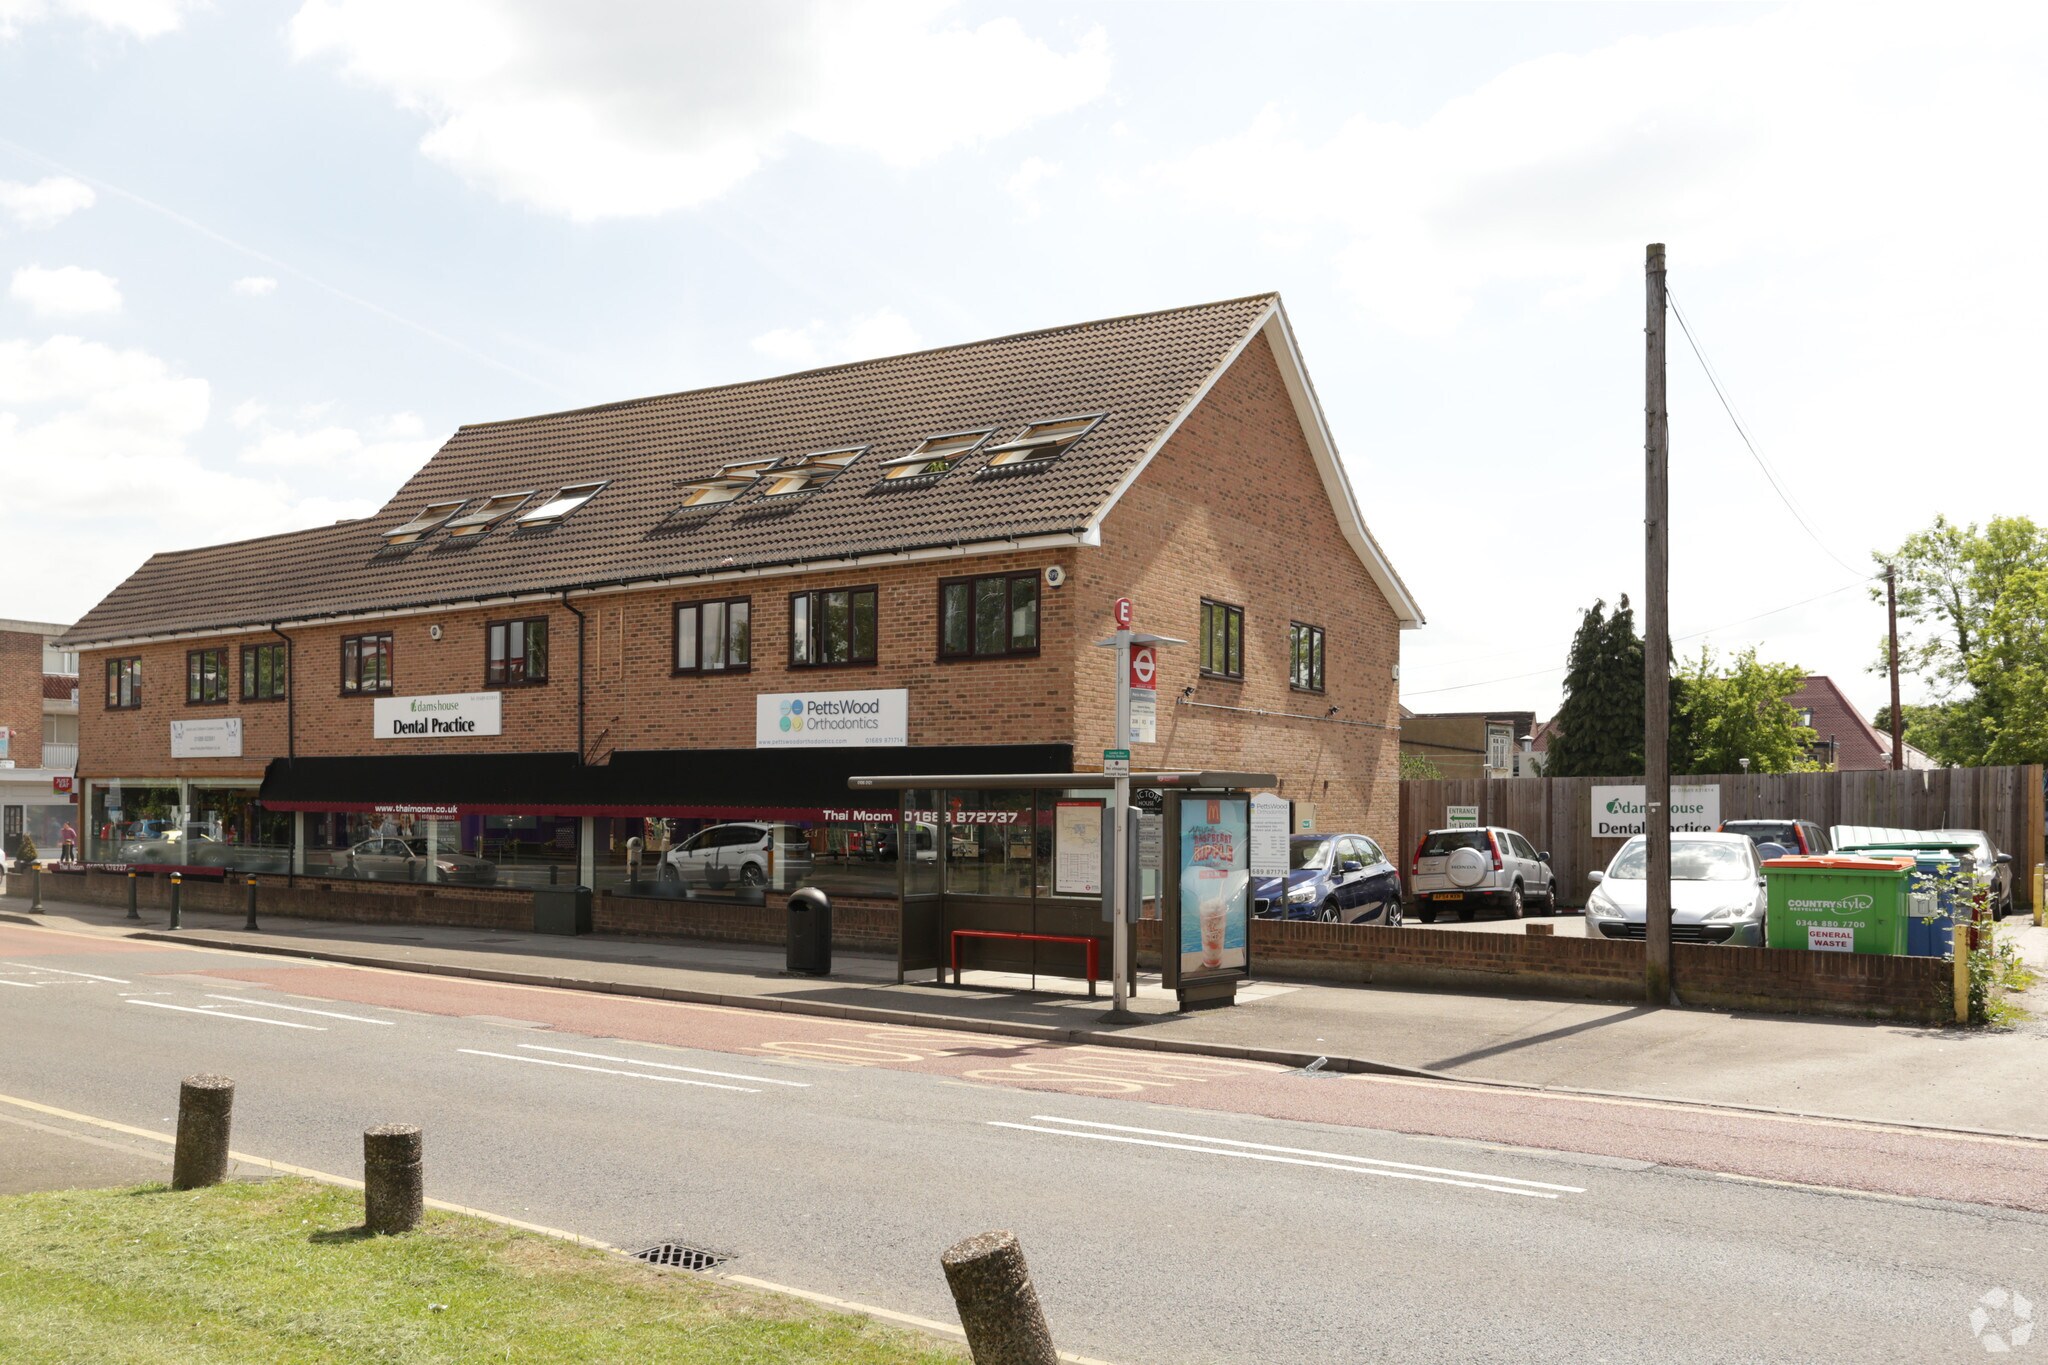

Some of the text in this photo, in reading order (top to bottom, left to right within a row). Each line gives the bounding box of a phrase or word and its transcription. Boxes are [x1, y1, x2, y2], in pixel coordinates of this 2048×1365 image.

[1120, 601, 1129, 622] E
[393, 716, 475, 734] Dental Practice
[807, 717, 879, 730] Orthodontics
[1136, 789, 1162, 803] ICTORY
[375, 804, 458, 813] www.thaimoom.co.uk
[823, 810, 849, 821] Thai
[853, 811, 893, 822] Moom
[956, 812, 1018, 823] 872737
[1194, 843, 1233, 862] RIPPLE
[1796, 919, 1818, 927] 0344
[1809, 930, 1852, 939] GENERAL
[1814, 939, 1847, 947] WASTE
